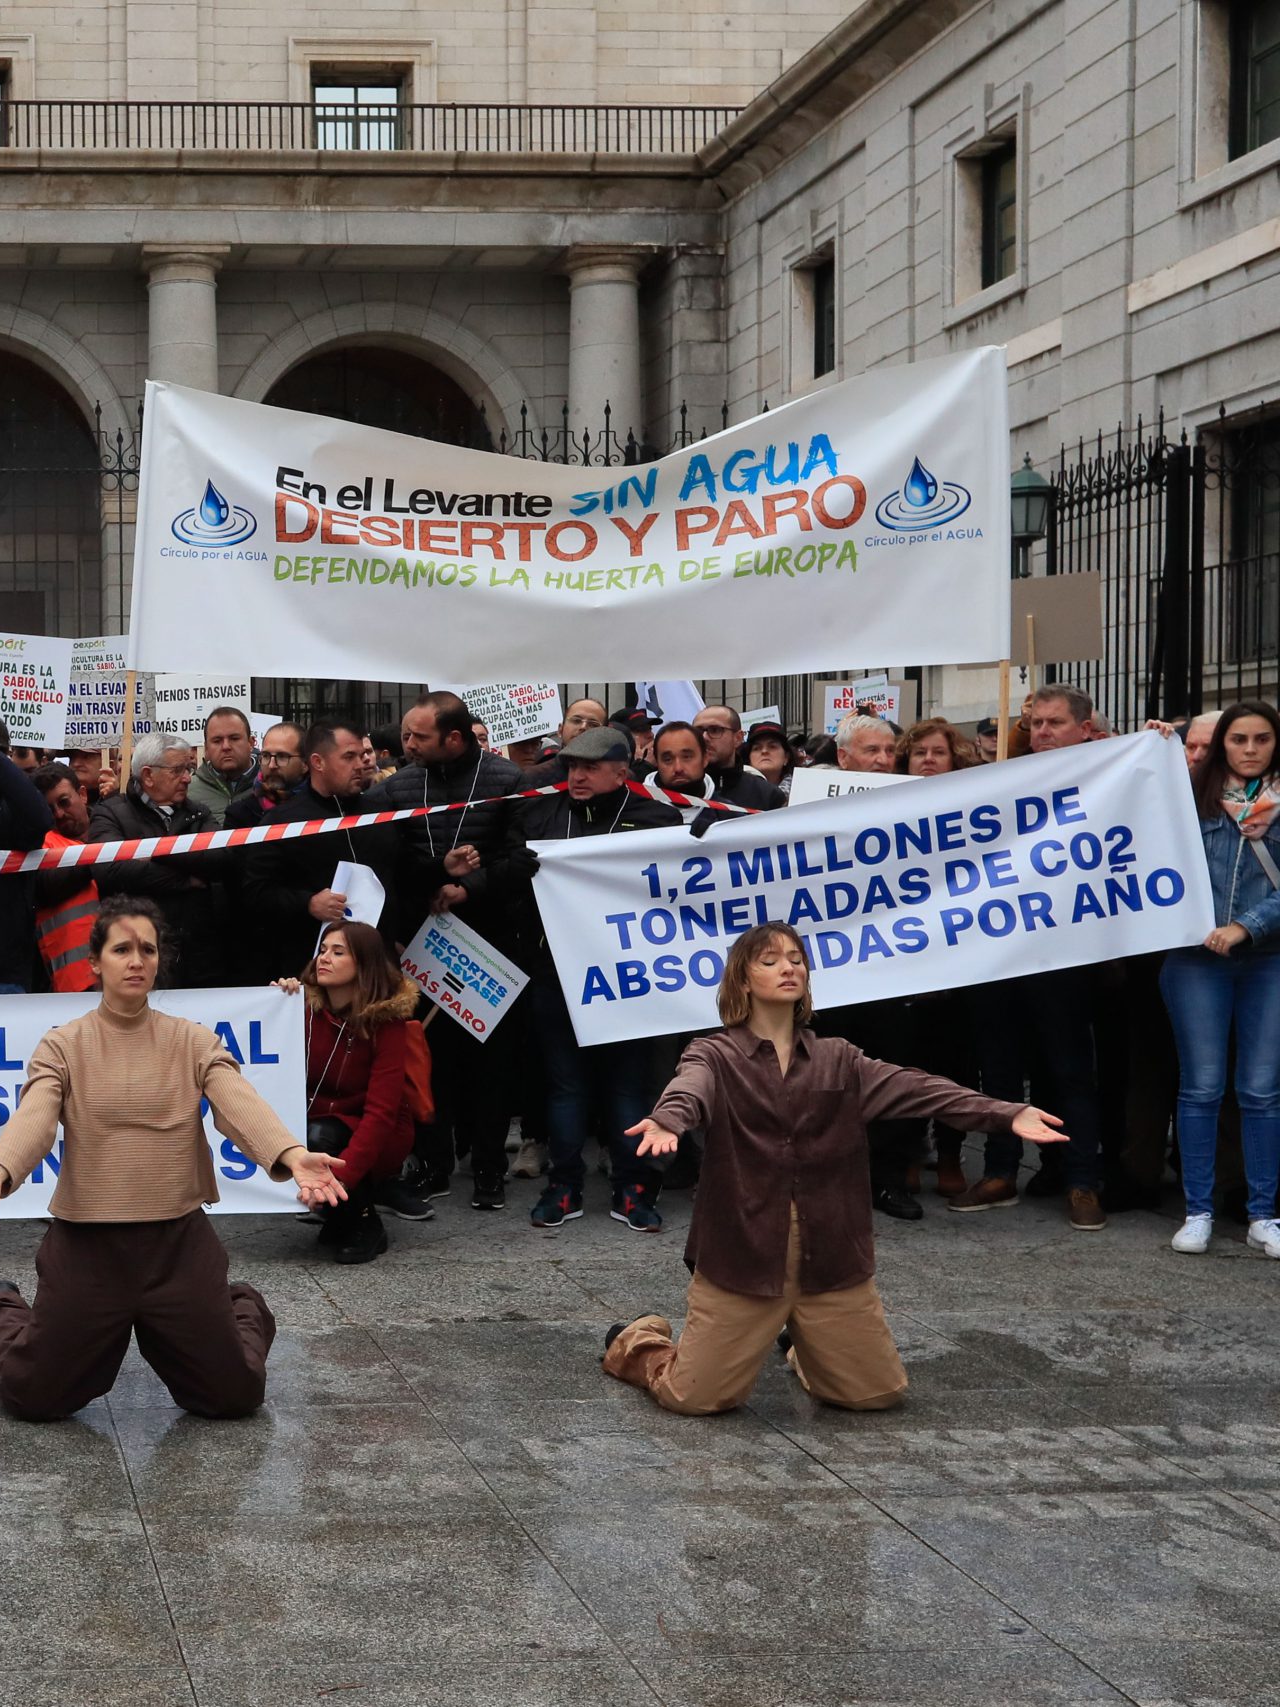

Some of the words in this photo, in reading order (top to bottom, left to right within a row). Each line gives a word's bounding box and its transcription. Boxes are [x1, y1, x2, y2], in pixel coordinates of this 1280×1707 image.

[275, 466, 326, 504] En
[337, 477, 371, 511] el
[384, 478, 553, 517] Levante
[569, 467, 658, 517] SIN
[679, 433, 840, 503] AGUA
[274, 491, 597, 562] DESIERTO
[610, 512, 660, 557] Y
[675, 474, 867, 551] PARO
[864, 535, 905, 547] Círculo
[909, 534, 928, 545] por
[932, 531, 942, 541] el
[947, 528, 983, 540] AGUA
[160, 547, 198, 558] Círculo
[202, 551, 220, 560] por
[237, 551, 268, 561] AGUA
[273, 555, 479, 589] DEFENDAMOS
[489, 566, 529, 590] LA
[544, 562, 665, 592] HUERTA
[679, 555, 721, 581] DE
[732, 539, 859, 579] EUROPA
[22, 664, 35, 675] ES
[40, 666, 53, 676] LA
[3, 676, 38, 690] SABIO,
[43, 679, 56, 690] LA
[80, 683, 92, 695] EL
[12, 689, 63, 704] SENCILLO
[156, 689, 190, 702] MENOS
[193, 684, 246, 700] TRASVASE
[518, 689, 555, 706] SENCILLO
[20, 702, 43, 715] MÁS
[4, 715, 32, 727] TODO
[112, 722, 118, 733] Y
[516, 714, 537, 726] TODO
[640, 856, 716, 904] 1,2
[727, 804, 1003, 890] MILLONES
[1015, 786, 1087, 836] DE
[605, 866, 932, 951] TONELADAS
[944, 850, 1020, 898] DE
[580, 915, 930, 1005] ABSOIDAS
[939, 891, 1057, 947] POR
[1071, 864, 1186, 924] AÑO
[428, 928, 507, 998] RECORTES
[424, 937, 501, 1008] TRASVASE
[401, 958, 439, 994] MÁS
[440, 991, 486, 1033] PARO
